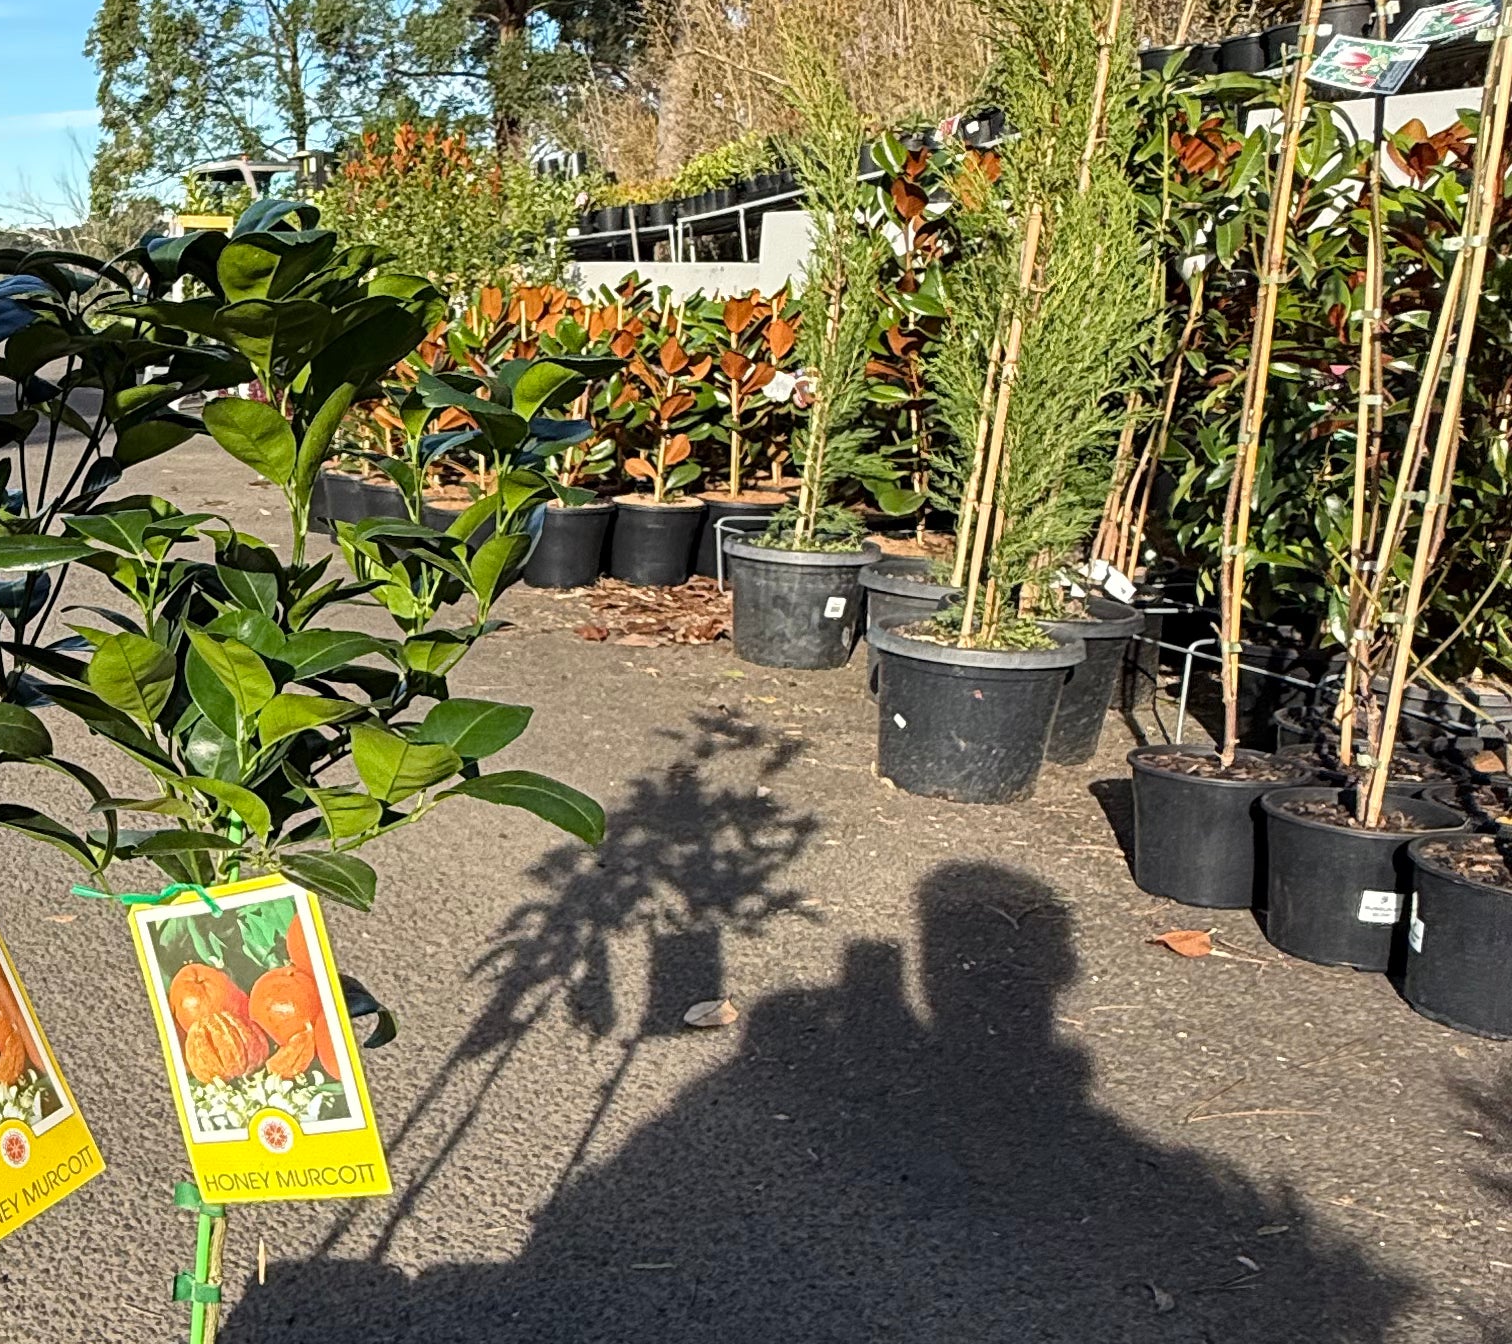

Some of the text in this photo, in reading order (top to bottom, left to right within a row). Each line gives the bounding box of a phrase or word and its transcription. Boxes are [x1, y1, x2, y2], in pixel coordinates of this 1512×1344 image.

[22, 1145, 94, 1206] MURCOTT
[203, 1163, 375, 1192] HONEY MURCOTT
